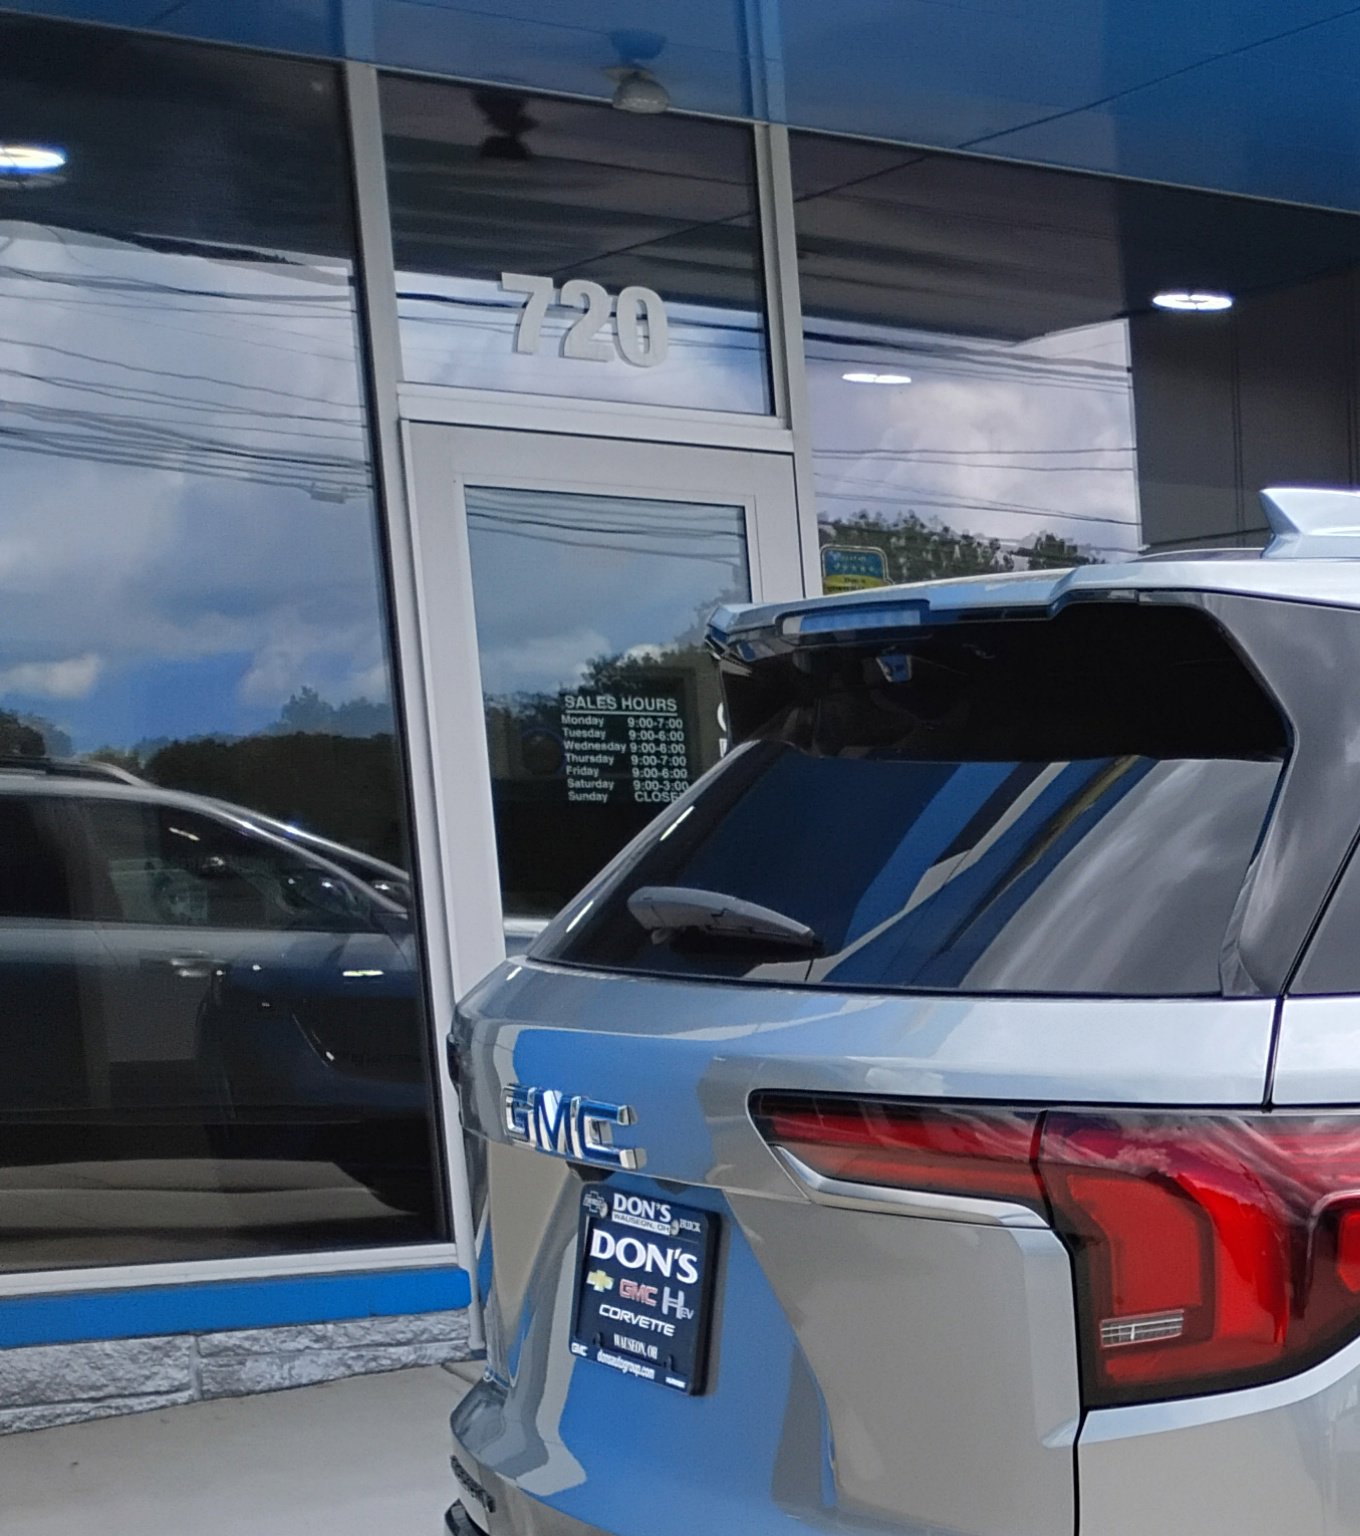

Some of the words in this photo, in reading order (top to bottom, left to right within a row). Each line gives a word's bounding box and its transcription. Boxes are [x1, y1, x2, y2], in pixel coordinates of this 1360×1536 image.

[500, 271, 668, 369] 720
[565, 695, 617, 710] SALES
[621, 697, 678, 712] HOURS
[561, 715, 604, 727] Monday
[627, 717, 683, 729] 9:00-7:00
[563, 728, 606, 740] Tuesday
[628, 730, 684, 742] 9:00-6:00
[564, 741, 626, 754] Wednesday
[565, 753, 614, 765] Thursday
[631, 755, 687, 767] 9:00-7:00
[566, 766, 599, 778] Friday
[632, 767, 688, 779] 9:00-6:00
[567, 779, 614, 791] Saturday
[633, 780, 690, 791] 9:00-3:00
[568, 791, 608, 803] Sunday
[634, 791, 684, 803] CLOSE
[501, 1084, 647, 1170] GMC
[613, 1192, 671, 1222] DON'S
[589, 1228, 699, 1285] DON'S
[619, 1278, 659, 1307] GMC
[598, 1304, 676, 1337] CORVETTE
